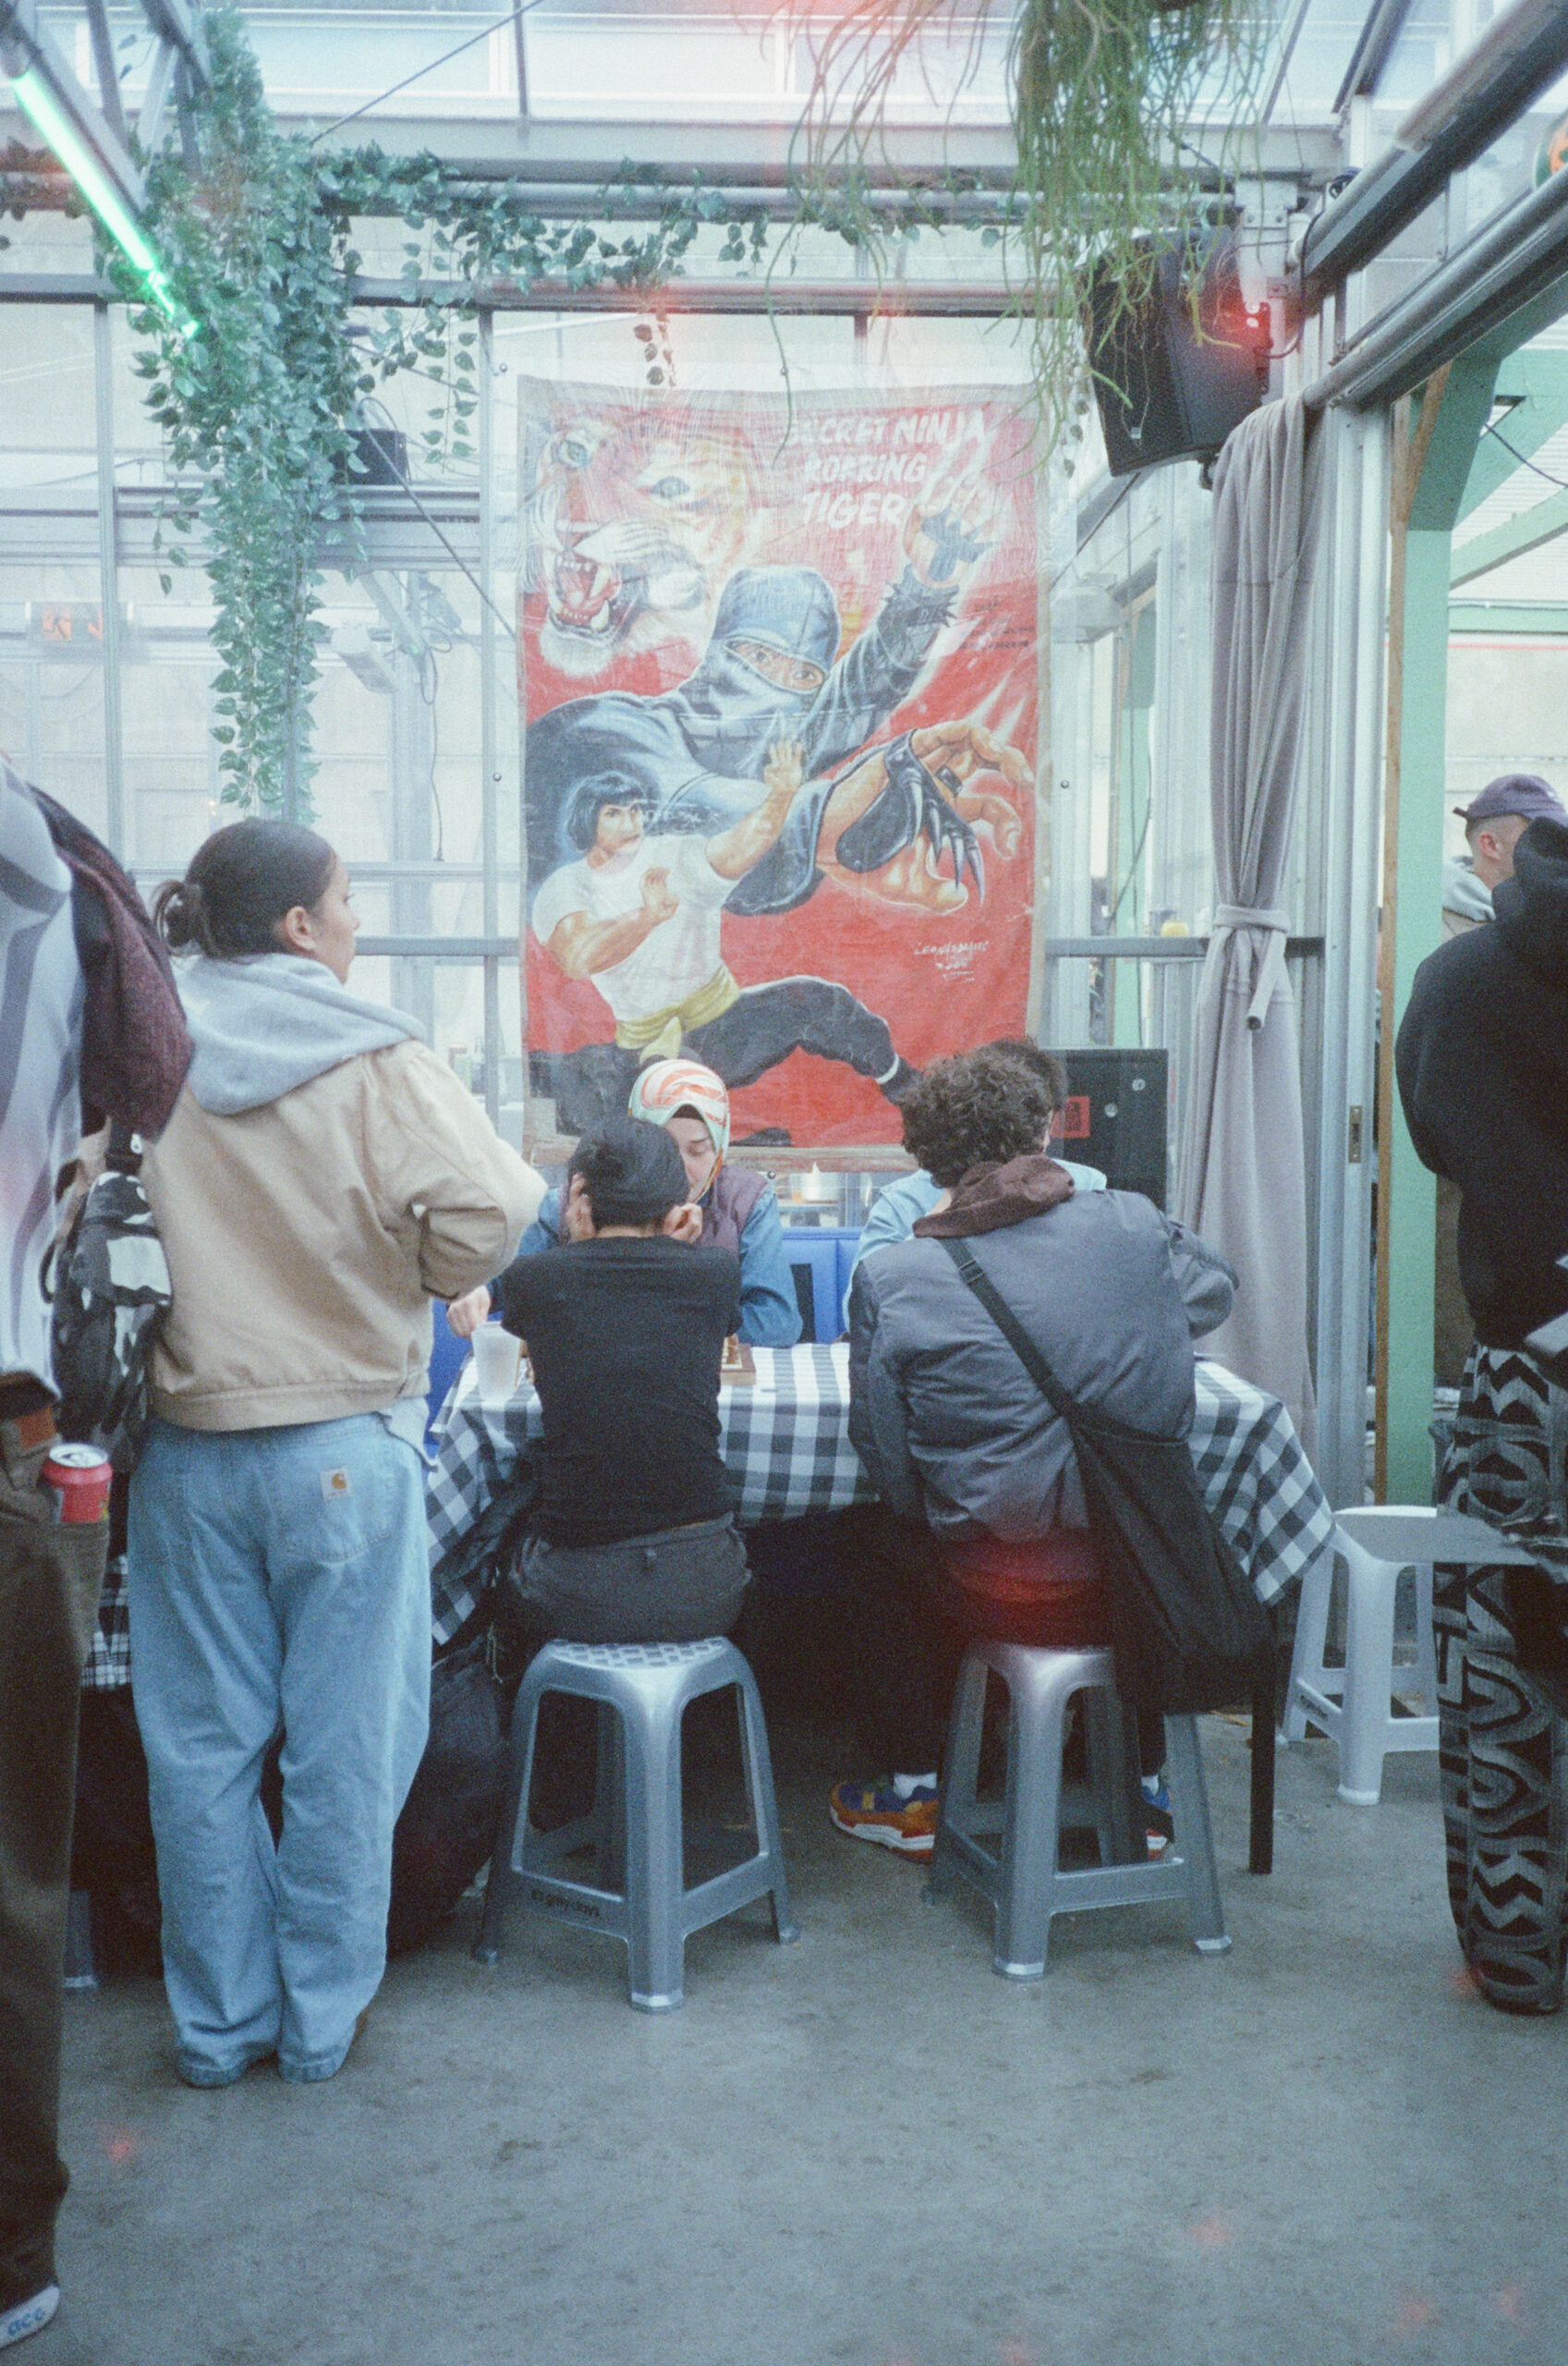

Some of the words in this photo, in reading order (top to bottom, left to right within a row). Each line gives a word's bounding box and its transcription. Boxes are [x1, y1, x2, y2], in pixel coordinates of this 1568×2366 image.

[893, 407, 986, 447] NINJA
[803, 452, 927, 483] ROARING
[802, 490, 910, 529] TIGER
